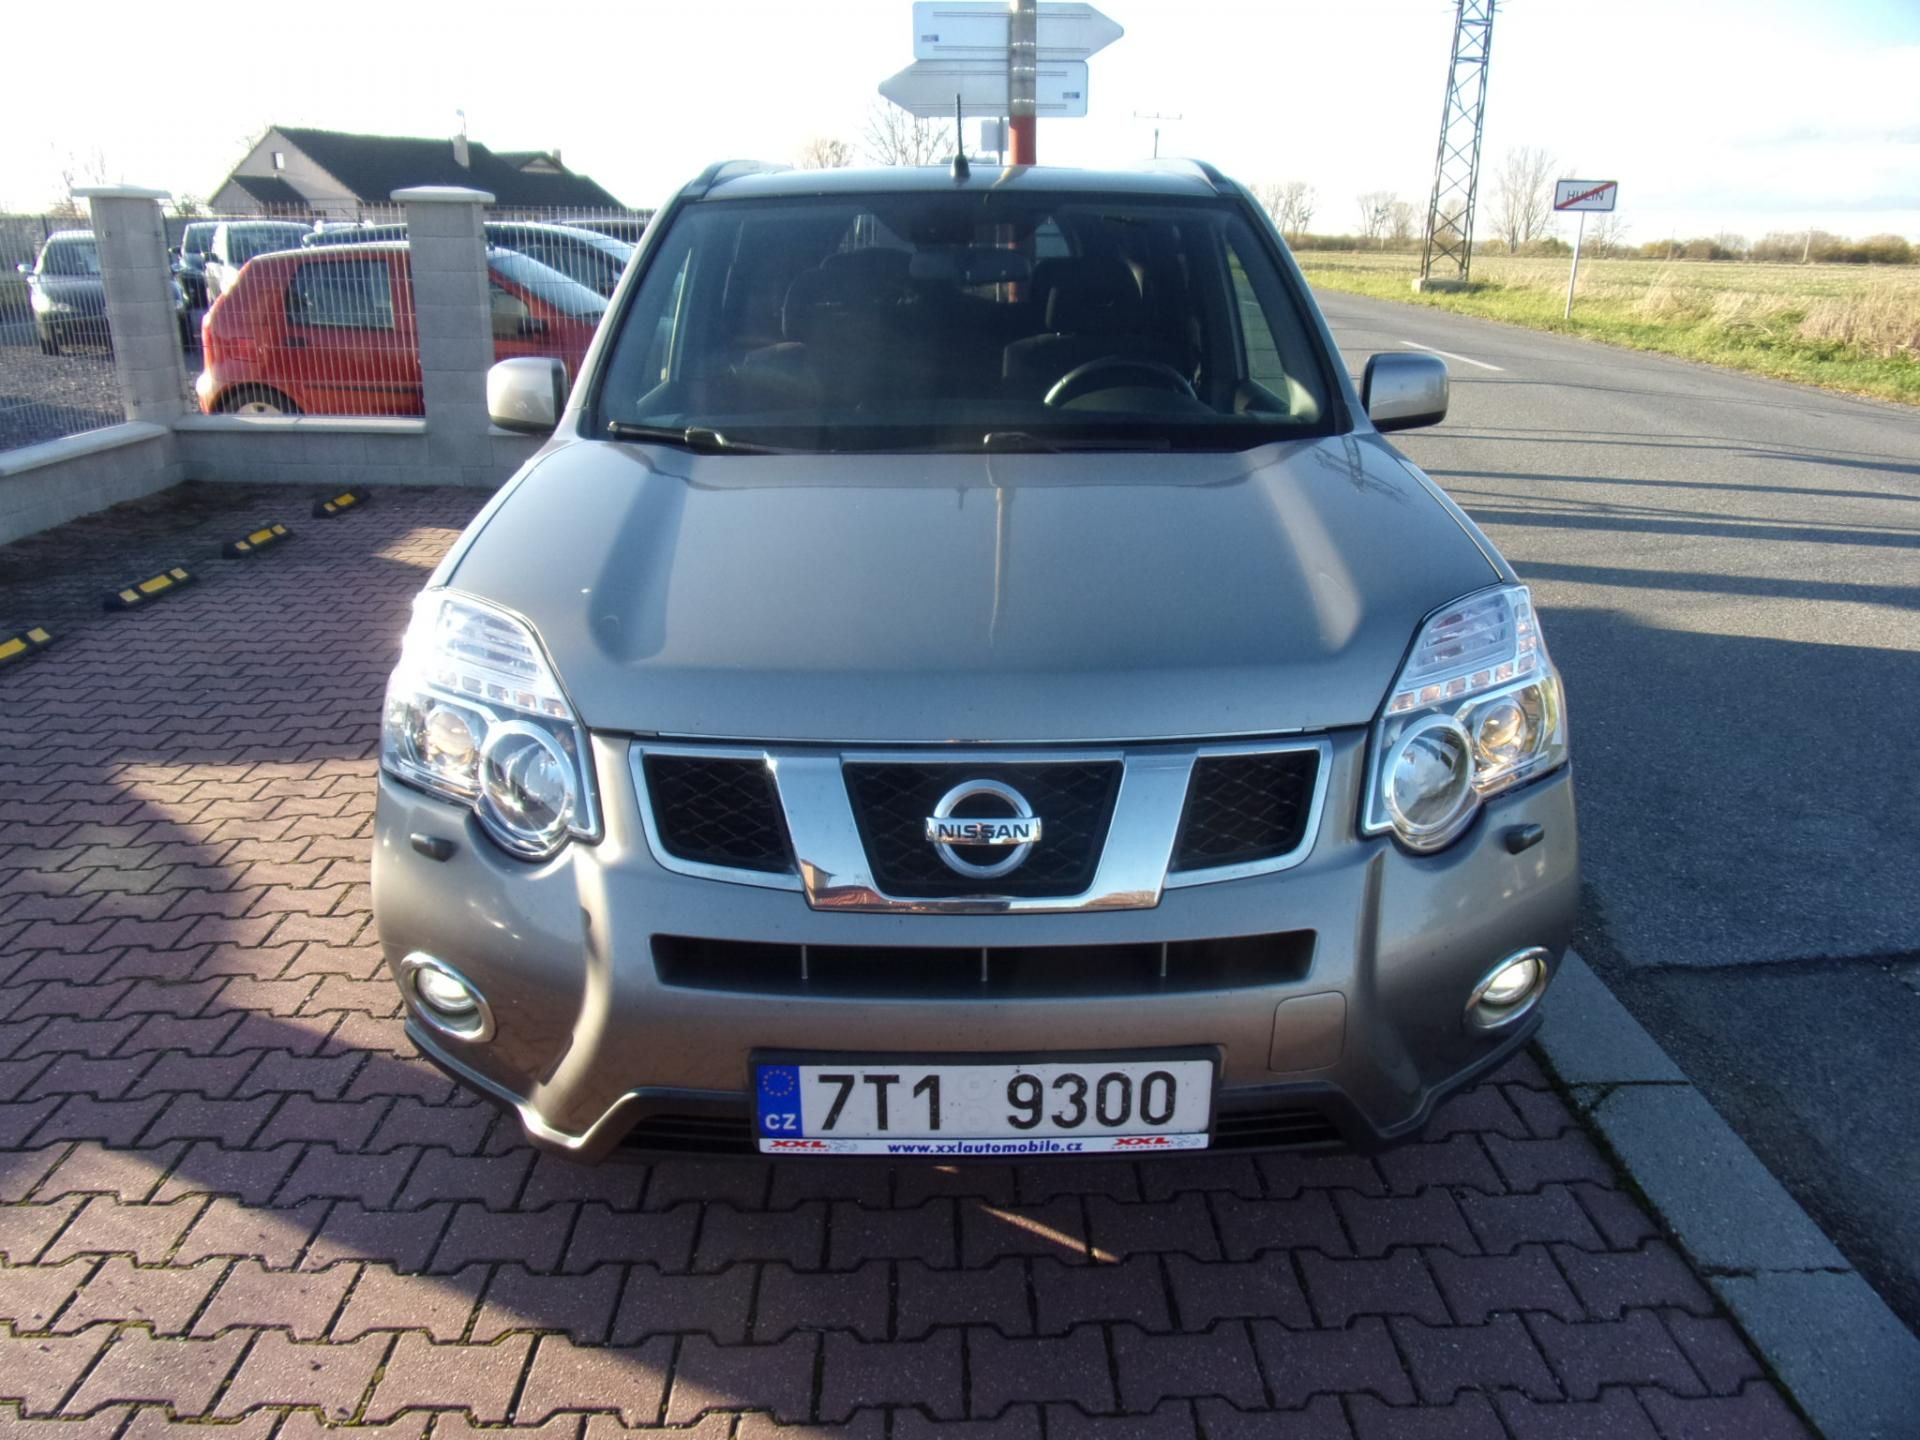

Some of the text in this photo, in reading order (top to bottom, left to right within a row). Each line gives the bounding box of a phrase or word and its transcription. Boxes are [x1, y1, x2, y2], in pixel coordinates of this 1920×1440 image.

[938, 823, 1030, 839] NISSAN
[817, 1071, 1178, 1131] 7T1 9300
[765, 1113, 797, 1130] CZ
[770, 1140, 827, 1149] XXL
[887, 1141, 1083, 1154] www.xxlautomobile.cz
[1113, 1136, 1170, 1147] XXL
